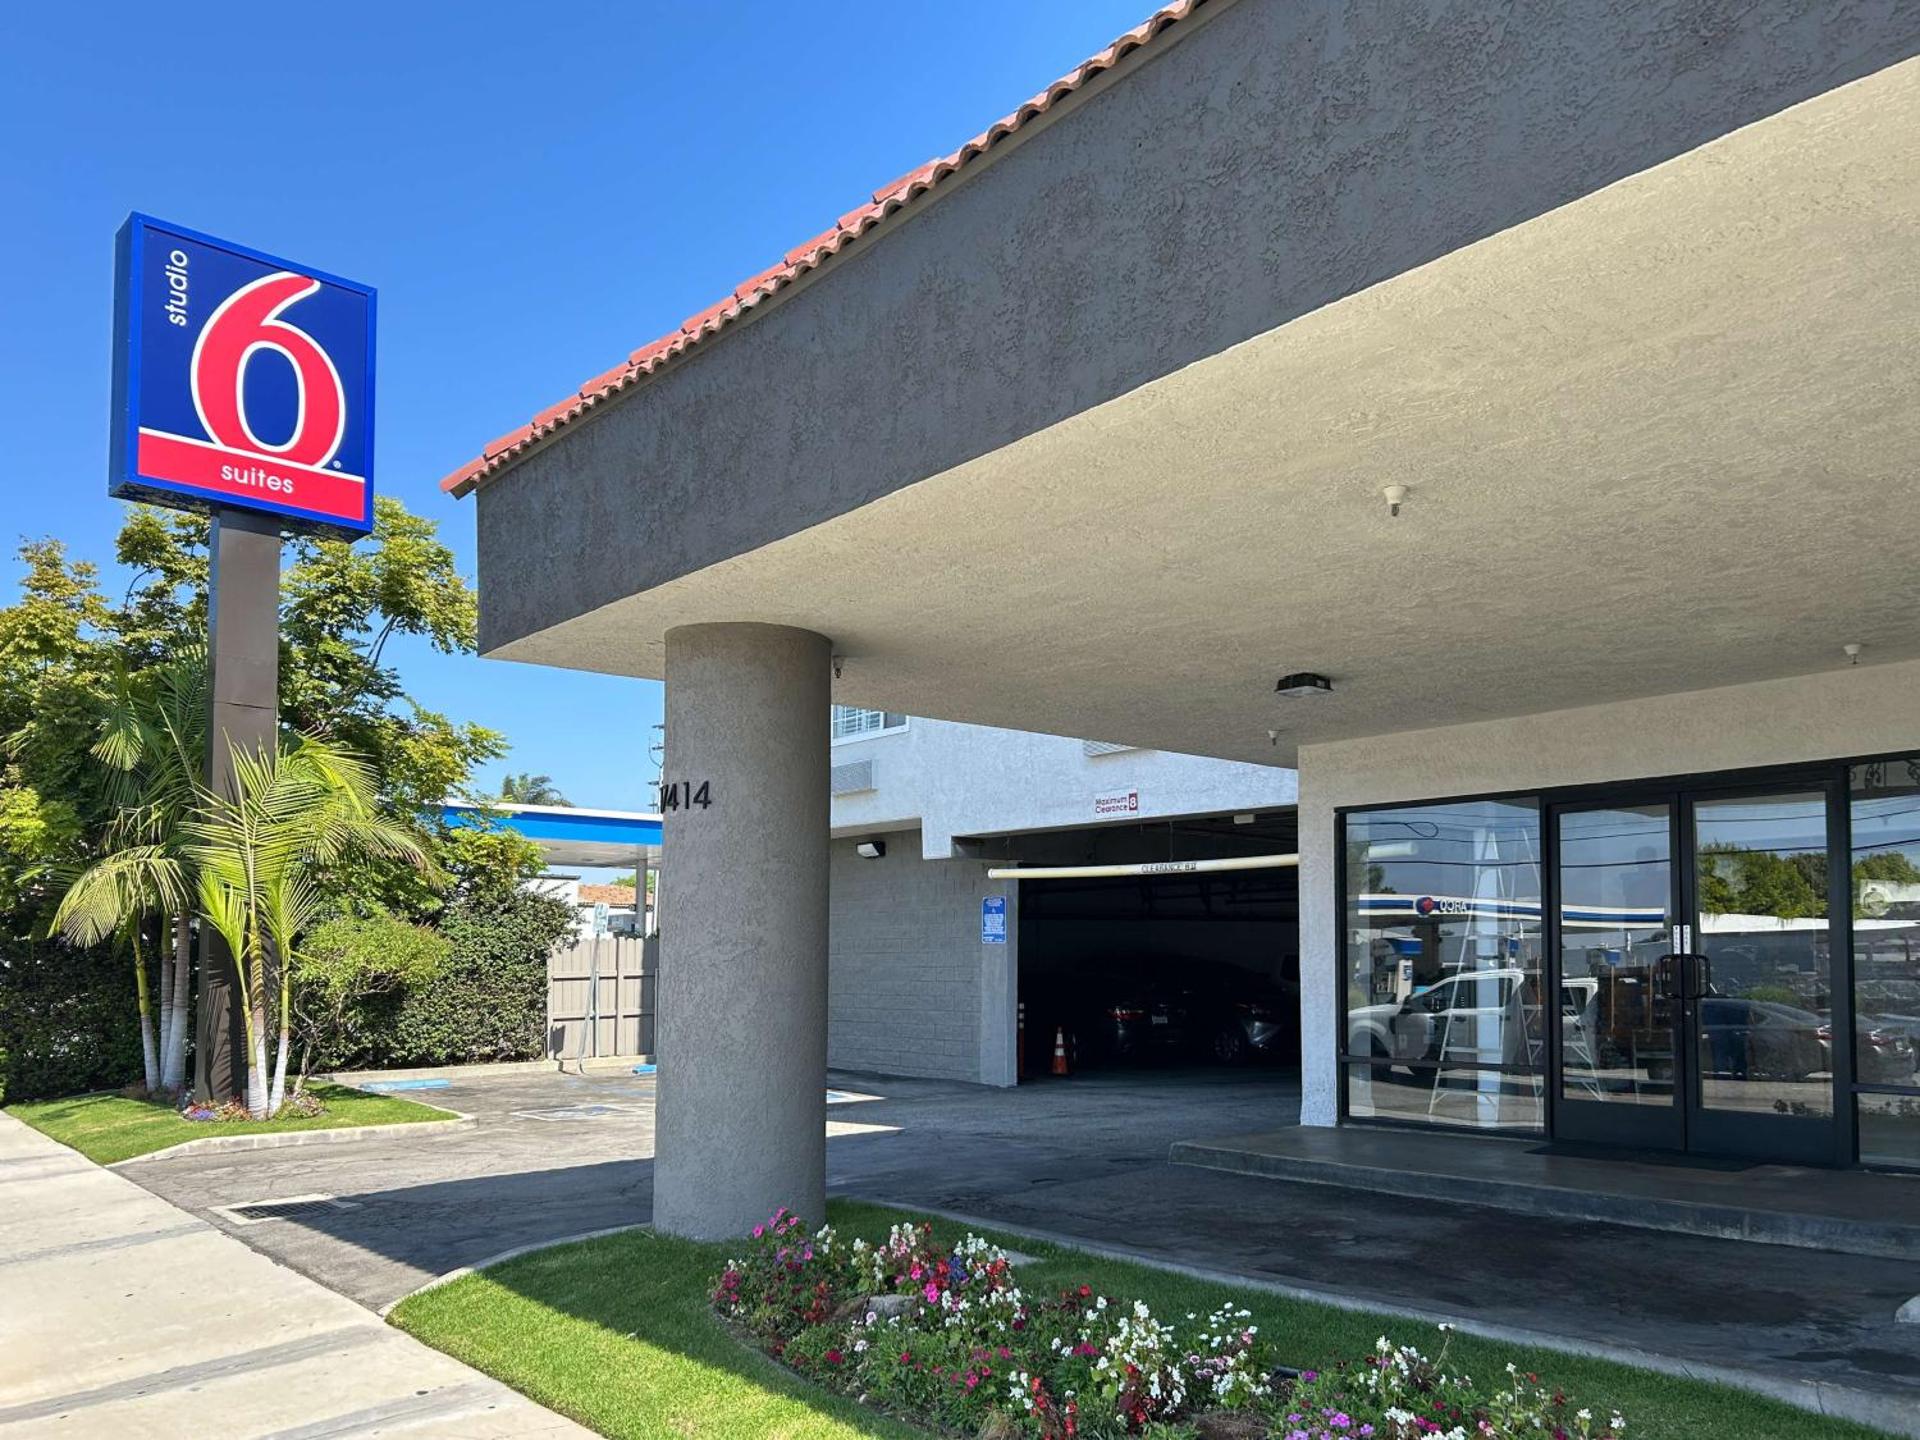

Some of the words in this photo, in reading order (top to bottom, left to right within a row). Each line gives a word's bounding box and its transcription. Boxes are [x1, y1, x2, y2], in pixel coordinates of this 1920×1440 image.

[164, 250, 188, 327] studio
[190, 270, 346, 469] 6
[221, 464, 295, 494] suites
[1095, 796, 1127, 805] Maximum
[1095, 804, 1128, 814] Clearance
